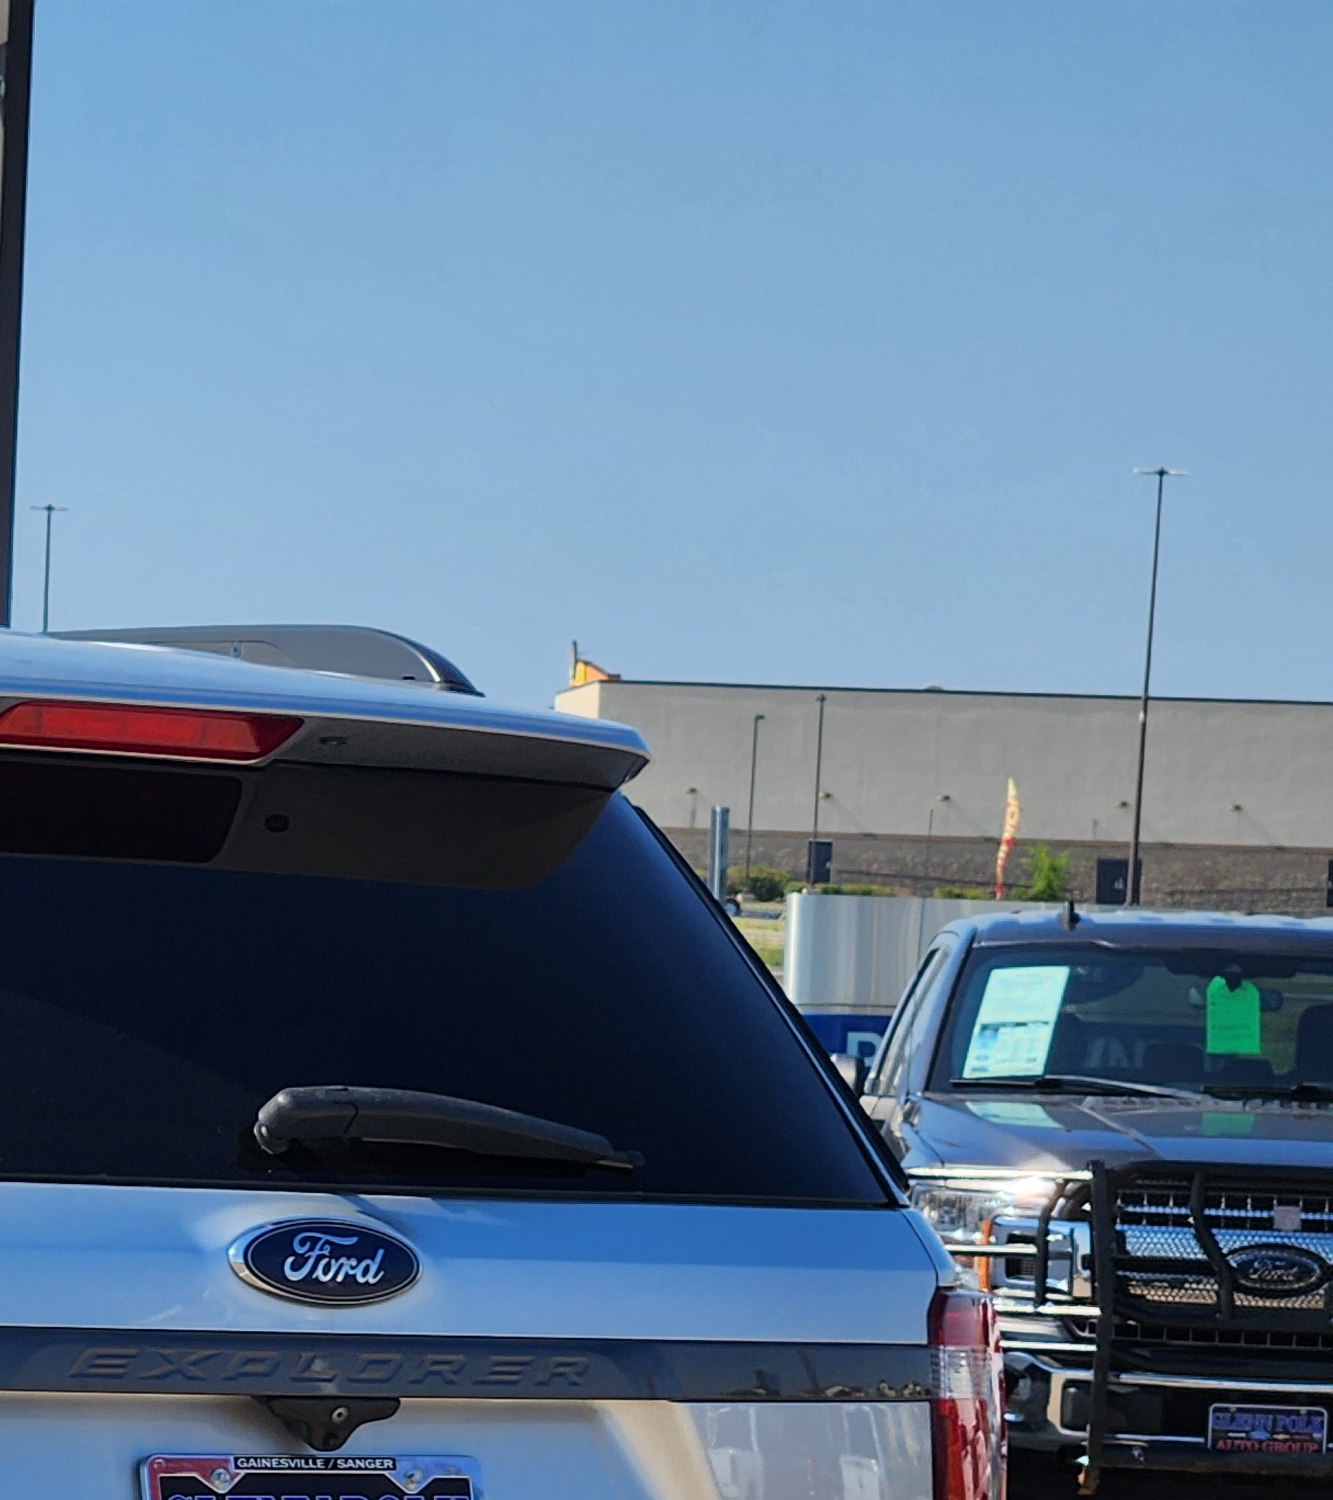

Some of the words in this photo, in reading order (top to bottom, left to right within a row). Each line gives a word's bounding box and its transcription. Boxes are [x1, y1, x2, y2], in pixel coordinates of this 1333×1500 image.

[283, 1231, 385, 1285] Ford
[68, 1350, 590, 1387] EXPLORER
[1217, 1440, 1260, 1451] AUTO
[1262, 1441, 1319, 1453] GROUP
[237, 1457, 325, 1469] GAINESVILLE
[336, 1458, 394, 1470] SANGER
